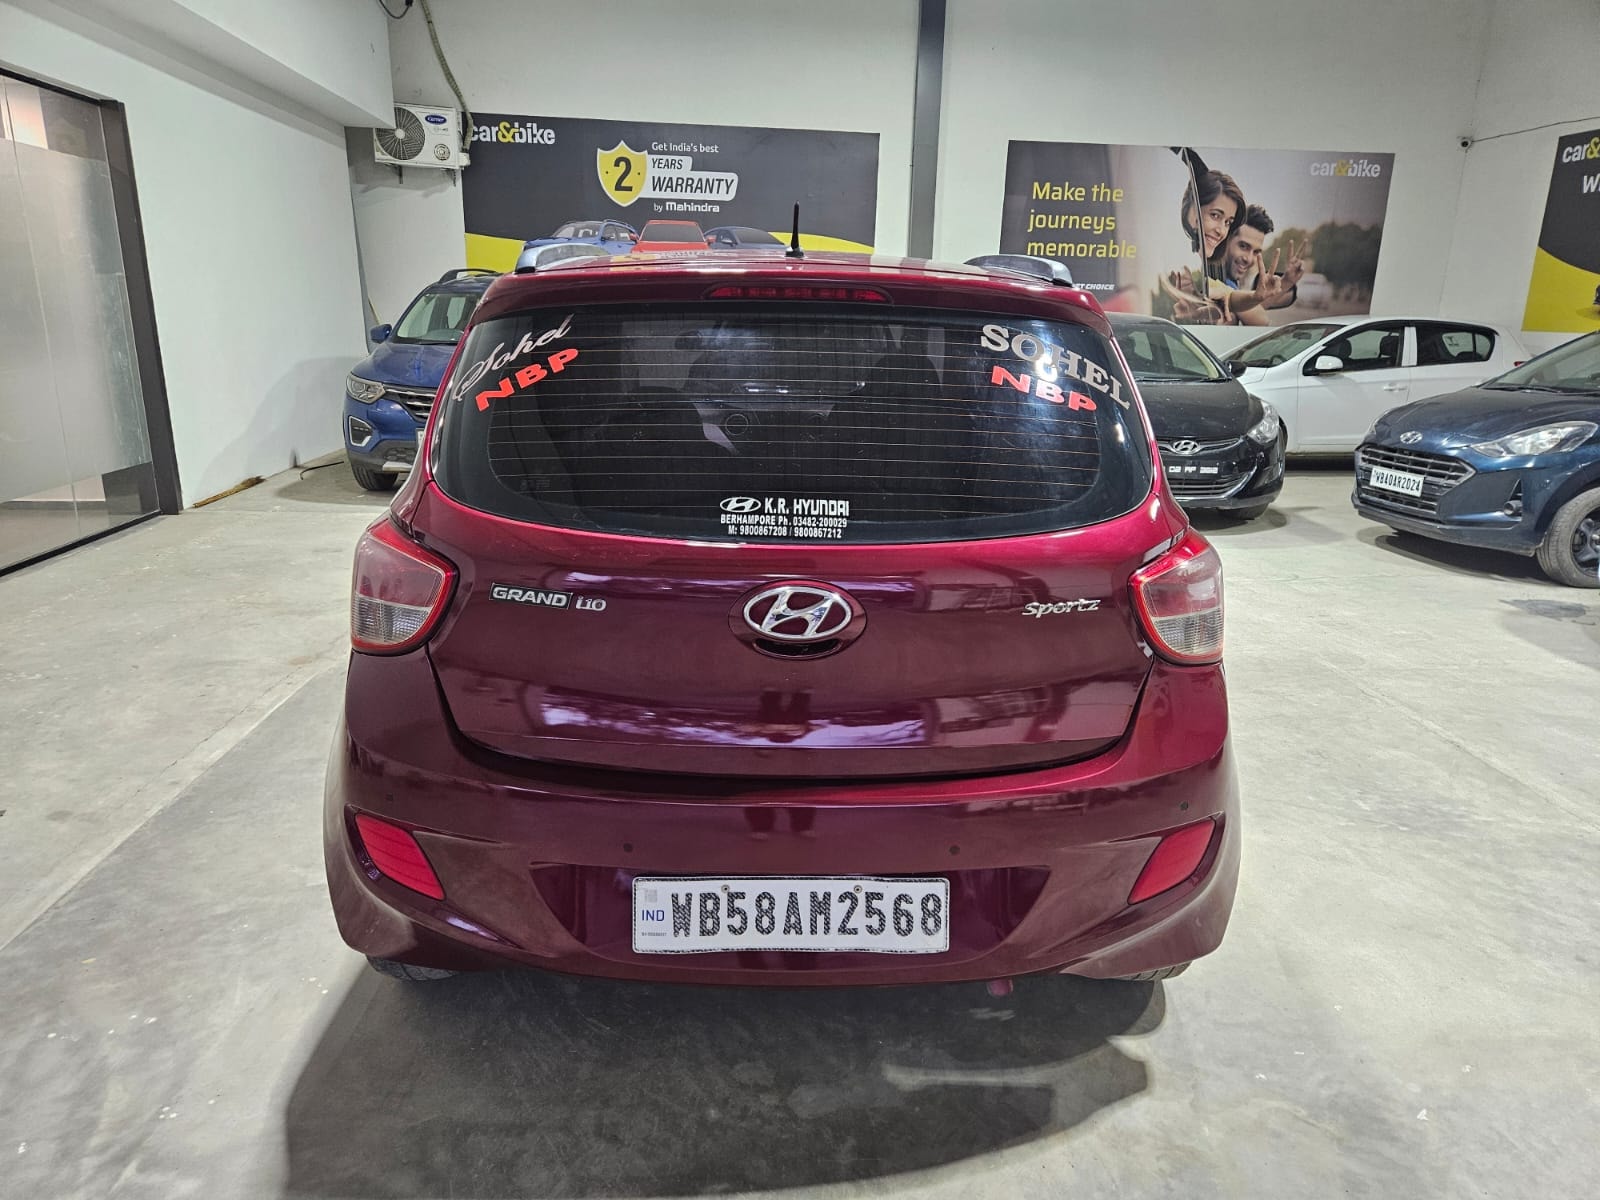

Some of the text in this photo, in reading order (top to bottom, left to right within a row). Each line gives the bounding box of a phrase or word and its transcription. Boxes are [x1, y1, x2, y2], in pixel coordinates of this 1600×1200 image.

[472, 121, 556, 145] car&bike
[651, 141, 719, 153] Get India's best
[1562, 136, 1600, 163] car&
[651, 157, 683, 170] YEARS
[1310, 158, 1381, 177] car&bike
[613, 156, 633, 192] 2
[651, 175, 734, 195] WARRANTY
[1032, 181, 1124, 202] Make the
[653, 201, 720, 213] by Mahindra
[1027, 209, 1116, 235] journeys
[1027, 240, 1137, 258] memorable
[980, 324, 1131, 410] SOHEL
[475, 348, 579, 412] NBP
[991, 365, 1097, 412] NBP
[764, 497, 850, 516] K.R. HYUNDAI
[720, 513, 776, 526] BERHAMPORE
[728, 525, 738, 535] M:
[492, 586, 607, 611] GRAND i10
[1022, 598, 1101, 618] Sportz
[642, 909, 665, 922] IND
[671, 891, 943, 938] WB58AM2568
